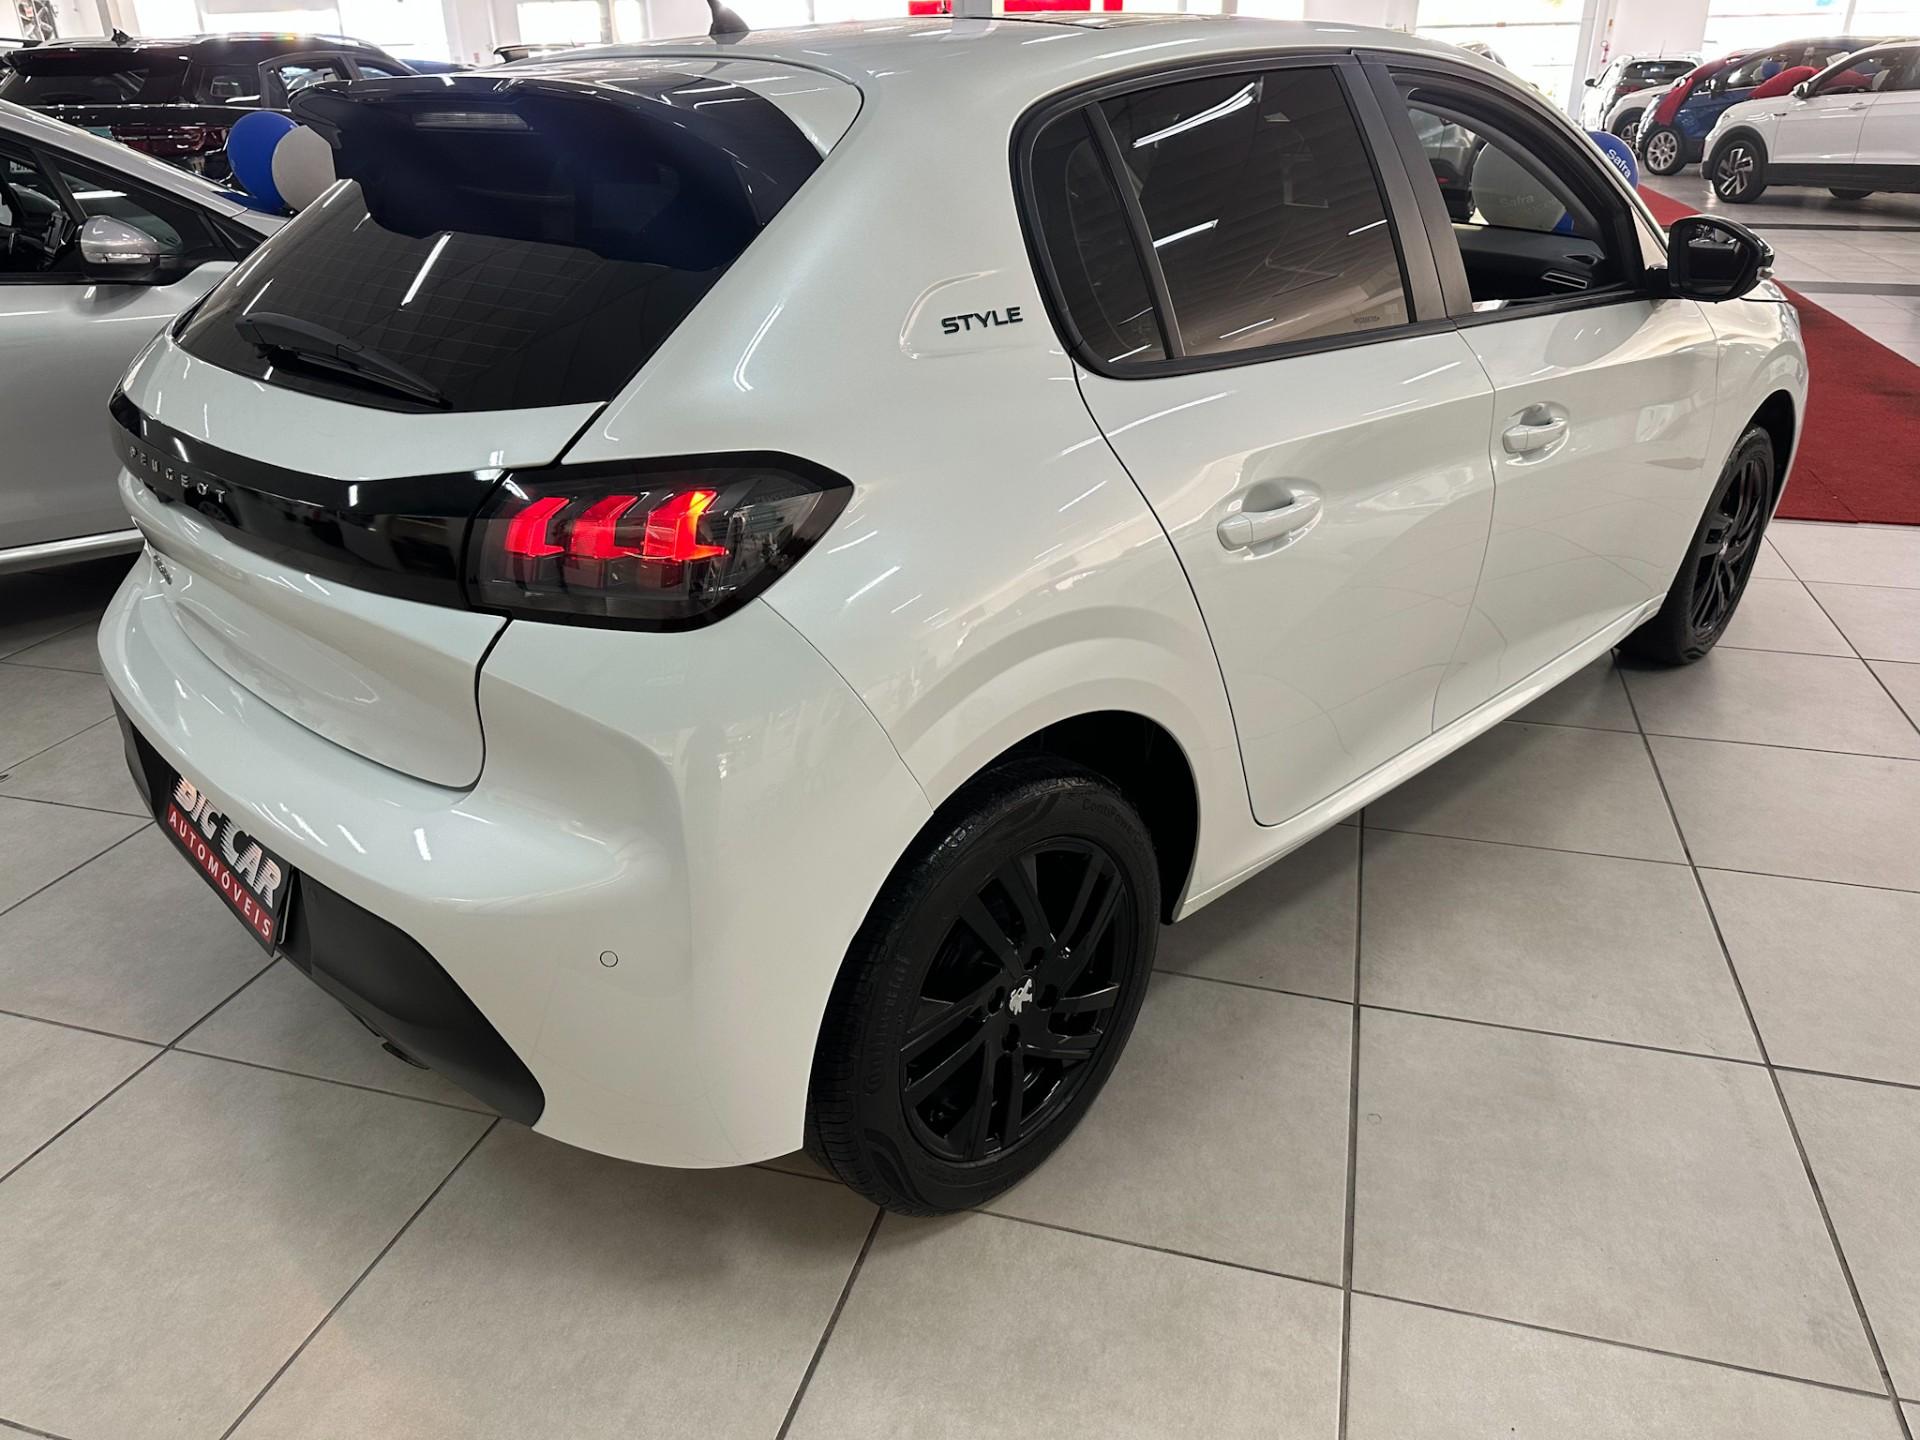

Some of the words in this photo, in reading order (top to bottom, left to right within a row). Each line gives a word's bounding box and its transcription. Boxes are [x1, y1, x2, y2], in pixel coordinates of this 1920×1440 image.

[1606, 148, 1631, 179] Safra
[941, 305, 1024, 335] STYLE
[129, 445, 226, 503] PEUGEOT
[172, 774, 220, 841] BIG
[220, 816, 282, 909] CAR
[169, 811, 271, 937] AUTOMÓVEIS
